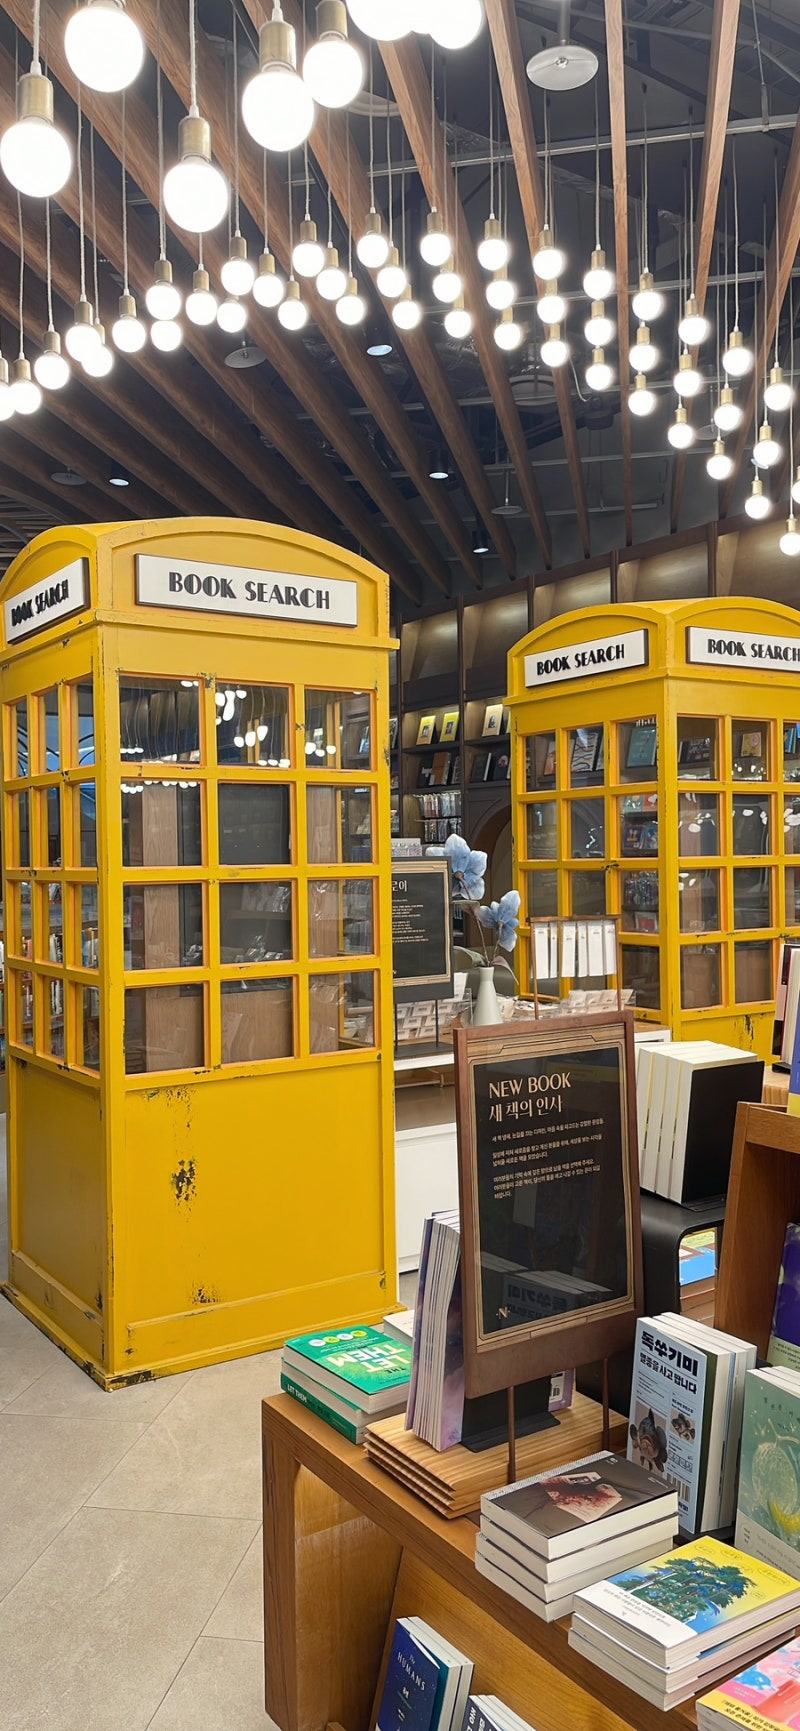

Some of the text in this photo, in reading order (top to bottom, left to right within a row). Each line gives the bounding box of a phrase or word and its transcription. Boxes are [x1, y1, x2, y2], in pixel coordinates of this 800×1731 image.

[11, 579, 69, 627] BOOK SEARCH
[169, 571, 330, 610] BOOK SEARCH
[537, 643, 625, 676] BOOK SEARCH
[708, 638, 800, 662] BOOK SEARCH
[489, 1072, 571, 1099] NEW BOOK
[489, 1095, 563, 1122] 새 책의 인사
[326, 1344, 406, 1367] THEM
[361, 1355, 411, 1373] LET
[641, 1331, 699, 1377] 독쏘기미
[659, 1365, 673, 1381] 사고
[397, 1651, 426, 1691] HUMANS
